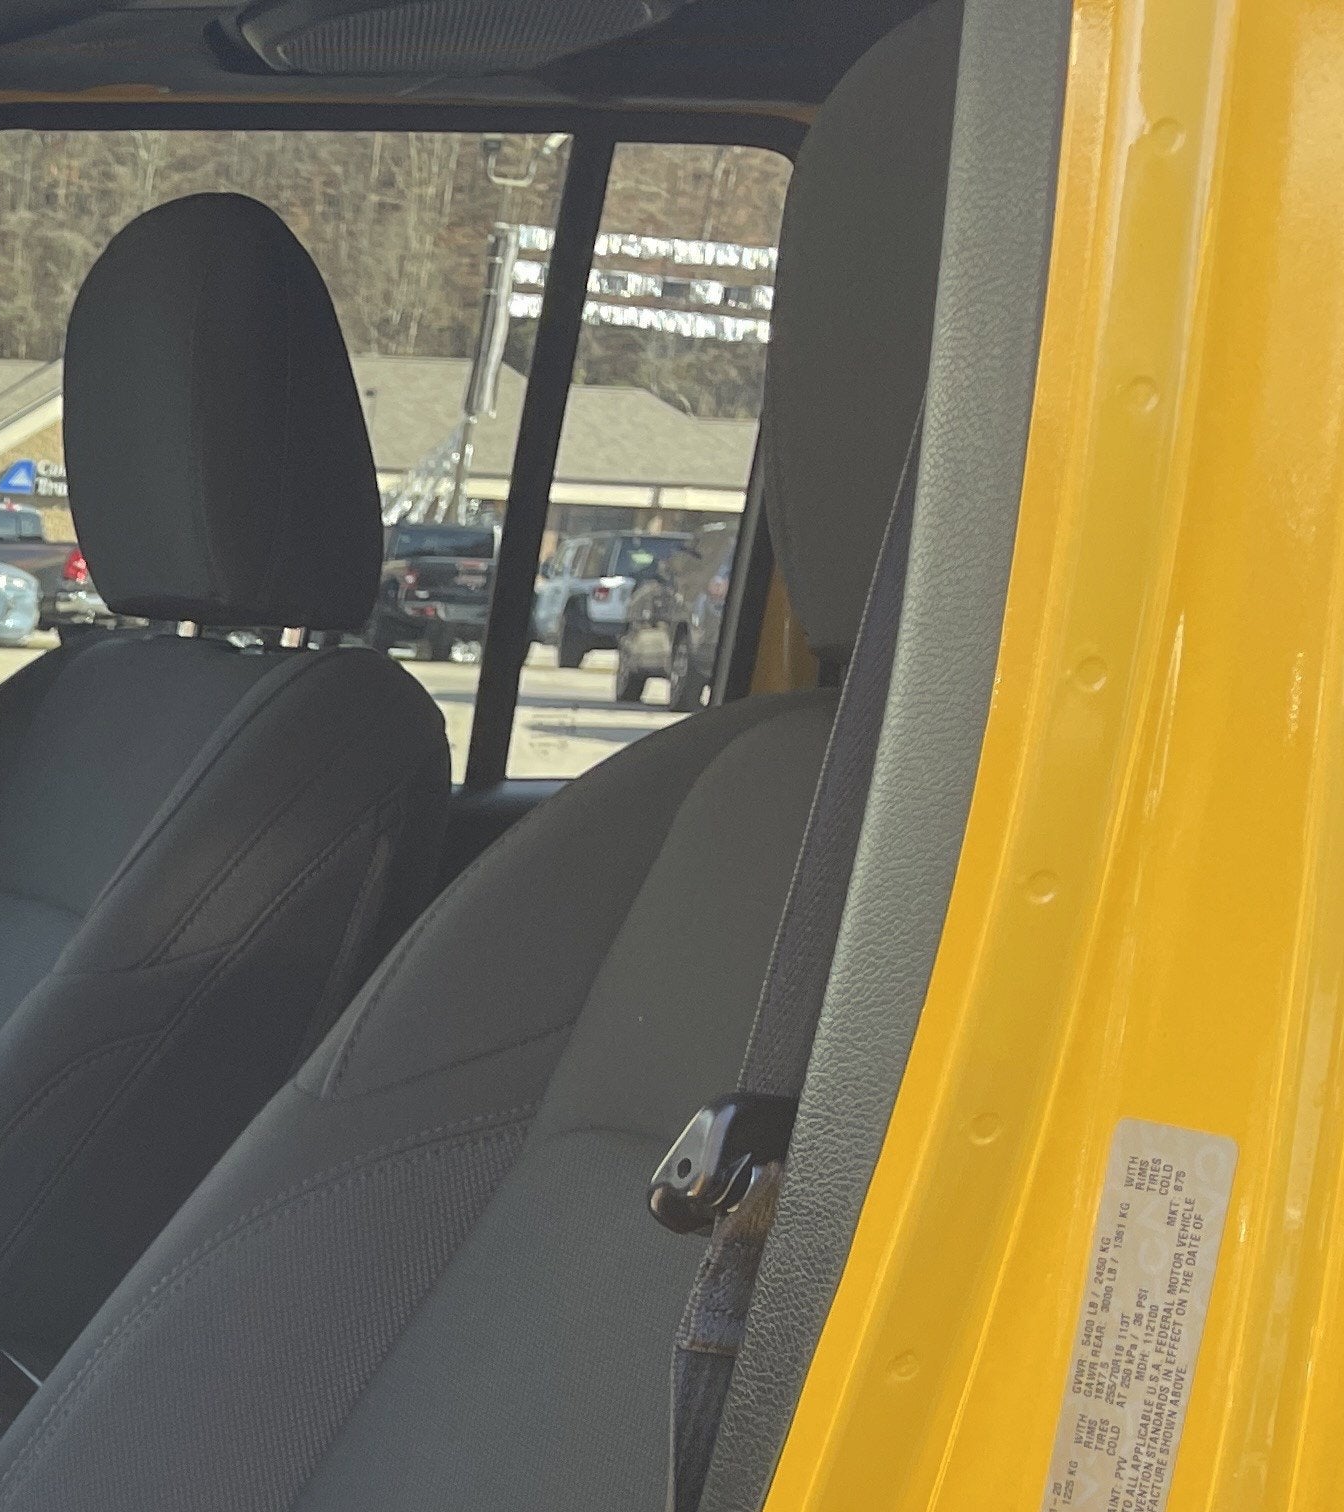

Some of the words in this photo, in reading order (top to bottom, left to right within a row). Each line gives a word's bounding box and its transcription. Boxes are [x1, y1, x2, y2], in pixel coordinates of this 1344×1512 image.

[1175, 1196, 1198, 1250] VEHICLE
[1192, 1212, 1208, 1232] OF
[1184, 1232, 1203, 1268] DATE
[1165, 1250, 1186, 1297] MOTOR
[1178, 1268, 1196, 1296] THE
[1174, 1296, 1190, 1318] ON
[1153, 1297, 1176, 1356] FEDERAL
[1163, 1318, 1185, 1367] EFFECT
[1160, 1366, 1175, 1383] IN
[1073, 1412, 1089, 1446] WITH
[1083, 1417, 1099, 1450] RIMS
[1128, 1397, 1155, 1472] APPLICABLE
[1144, 1383, 1171, 1460] STANDARDS
[1157, 1407, 1179, 1457] SHOWN
[1066, 1458, 1079, 1477] KG
[1123, 1471, 1139, 1498] ALL
[1060, 1477, 1075, 1506] 1225
